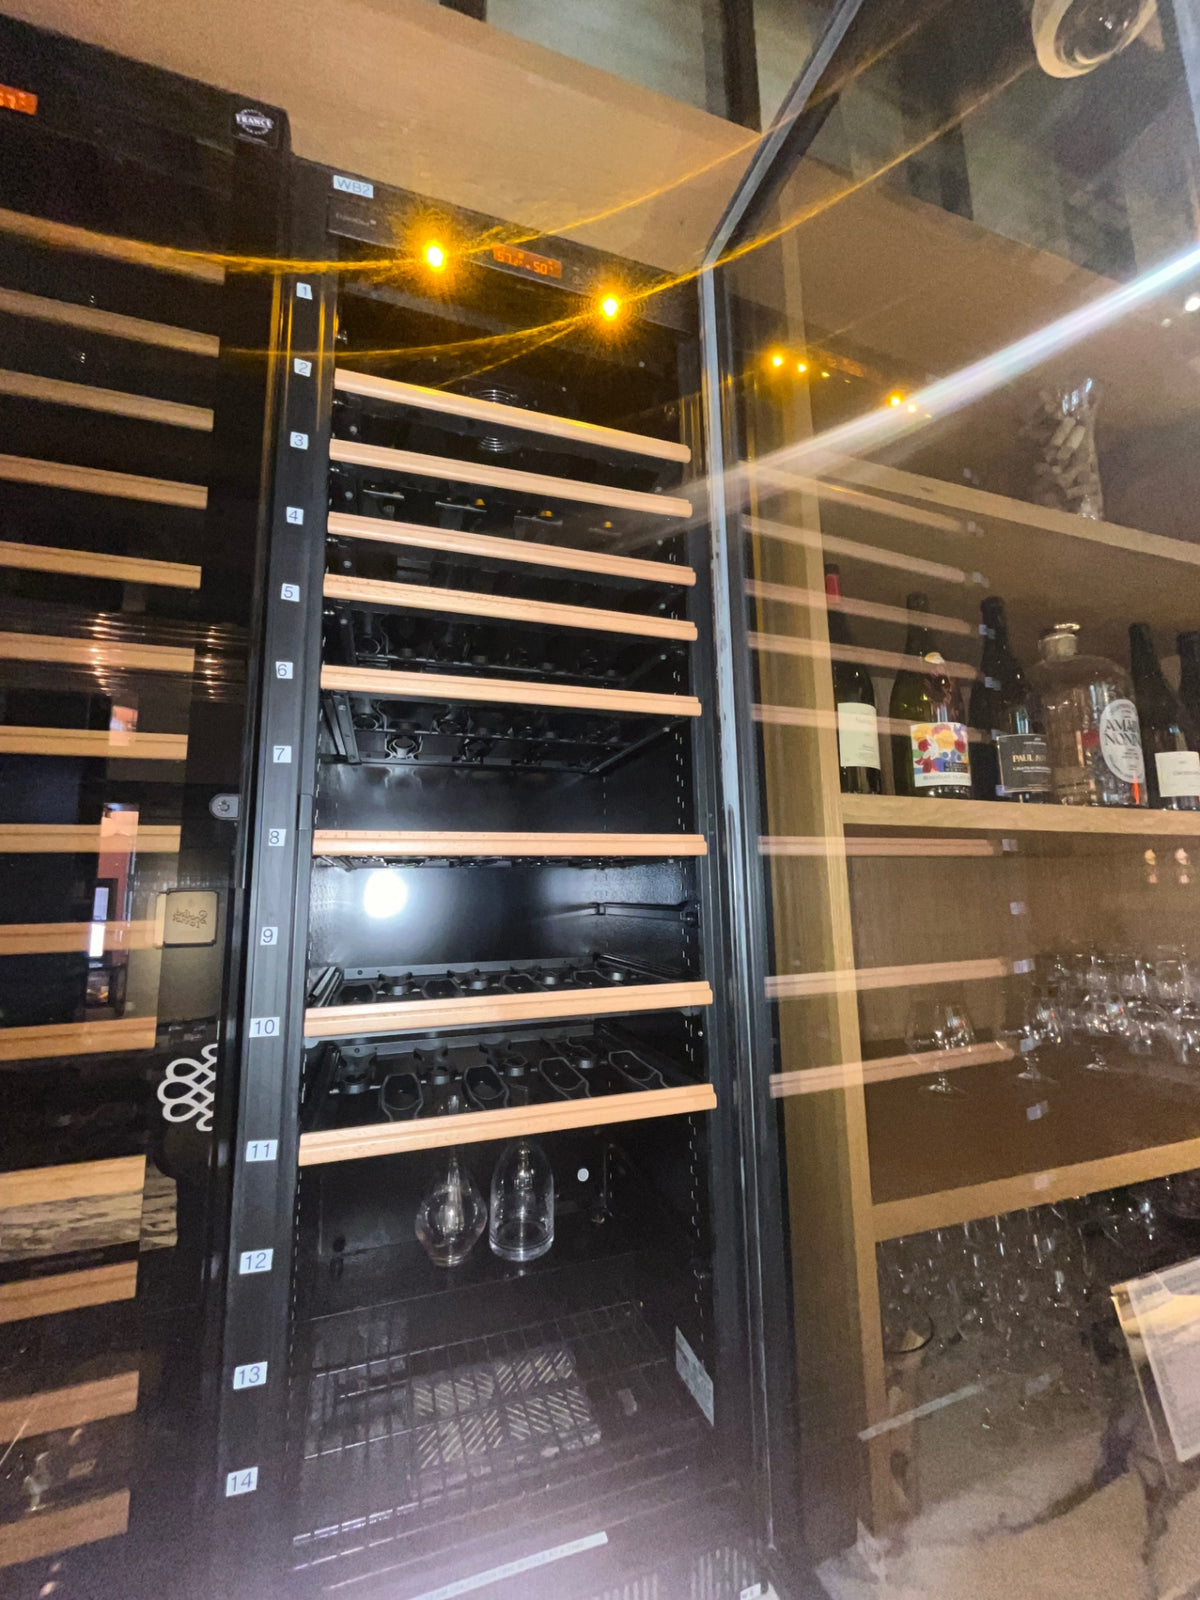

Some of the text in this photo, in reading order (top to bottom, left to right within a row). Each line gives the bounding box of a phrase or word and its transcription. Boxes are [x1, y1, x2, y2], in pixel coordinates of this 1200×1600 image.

[235, 113, 273, 129] FRANCE
[337, 177, 370, 195] WB2
[1012, 753, 1034, 763] PAUL
[254, 1019, 275, 1035] 10
[251, 1142, 271, 1159] 11
[245, 1251, 267, 1271] 12
[239, 1365, 261, 1385] 13
[231, 1471, 252, 1492] 14
